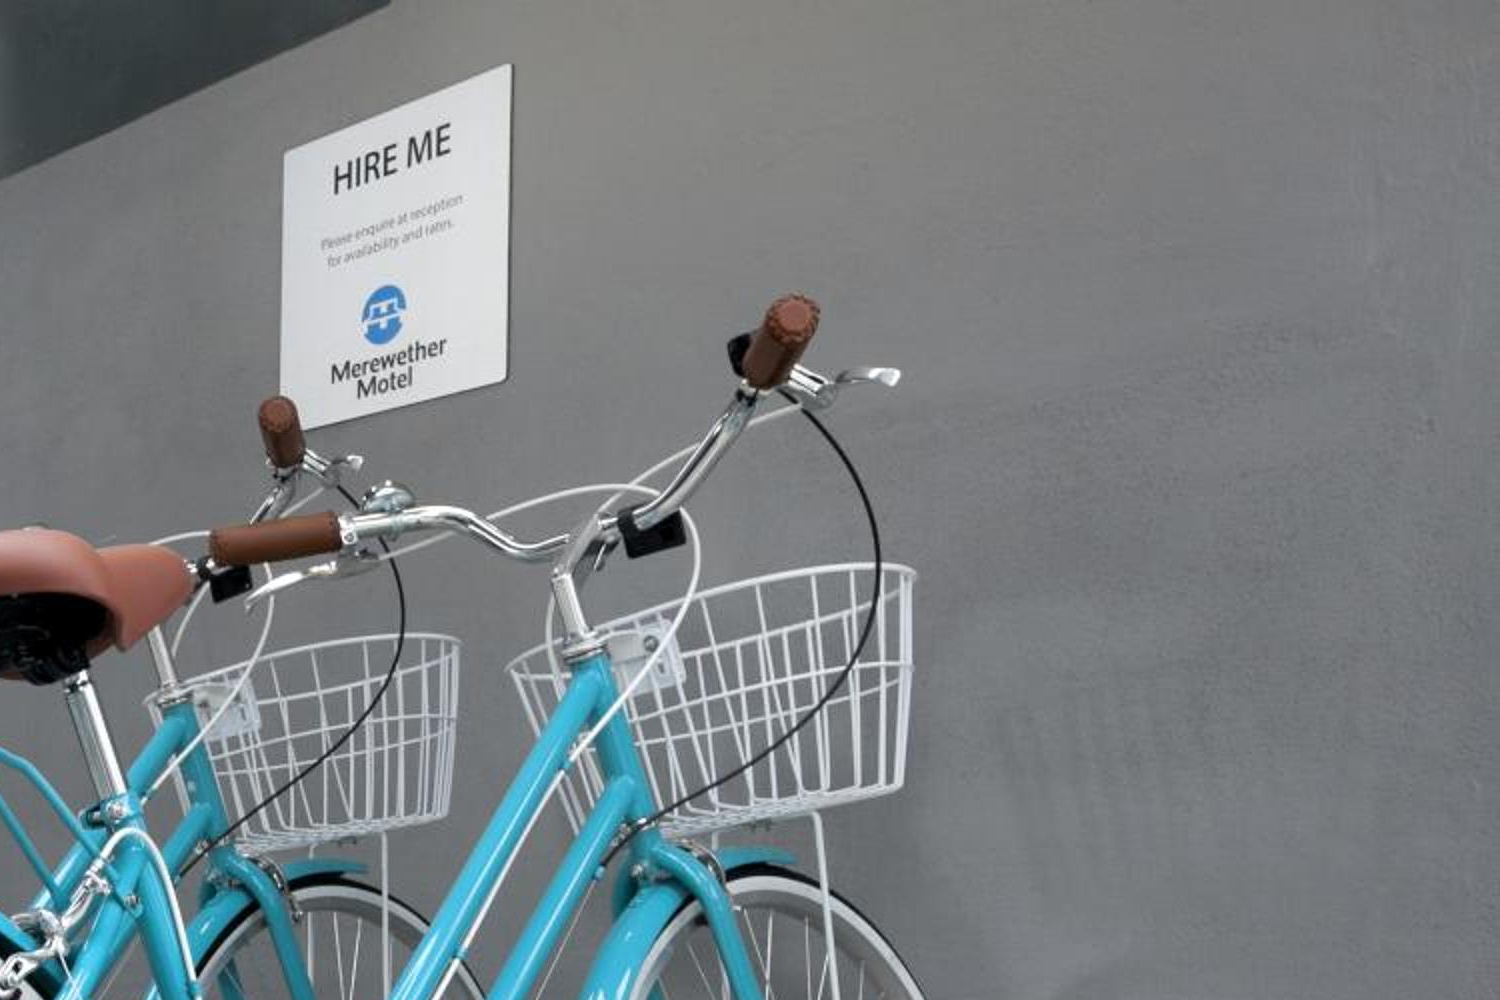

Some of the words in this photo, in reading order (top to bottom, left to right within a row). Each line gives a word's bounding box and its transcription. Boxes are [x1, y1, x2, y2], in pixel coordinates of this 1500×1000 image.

[333, 143, 398, 195] HIRE
[406, 122, 452, 169] ME
[321, 233, 352, 251] Please
[397, 212, 408, 225] at
[409, 194, 463, 220] reception
[327, 255, 342, 270] for
[401, 224, 424, 244] and
[330, 338, 448, 385] Merewether
[356, 366, 414, 400] Motel
